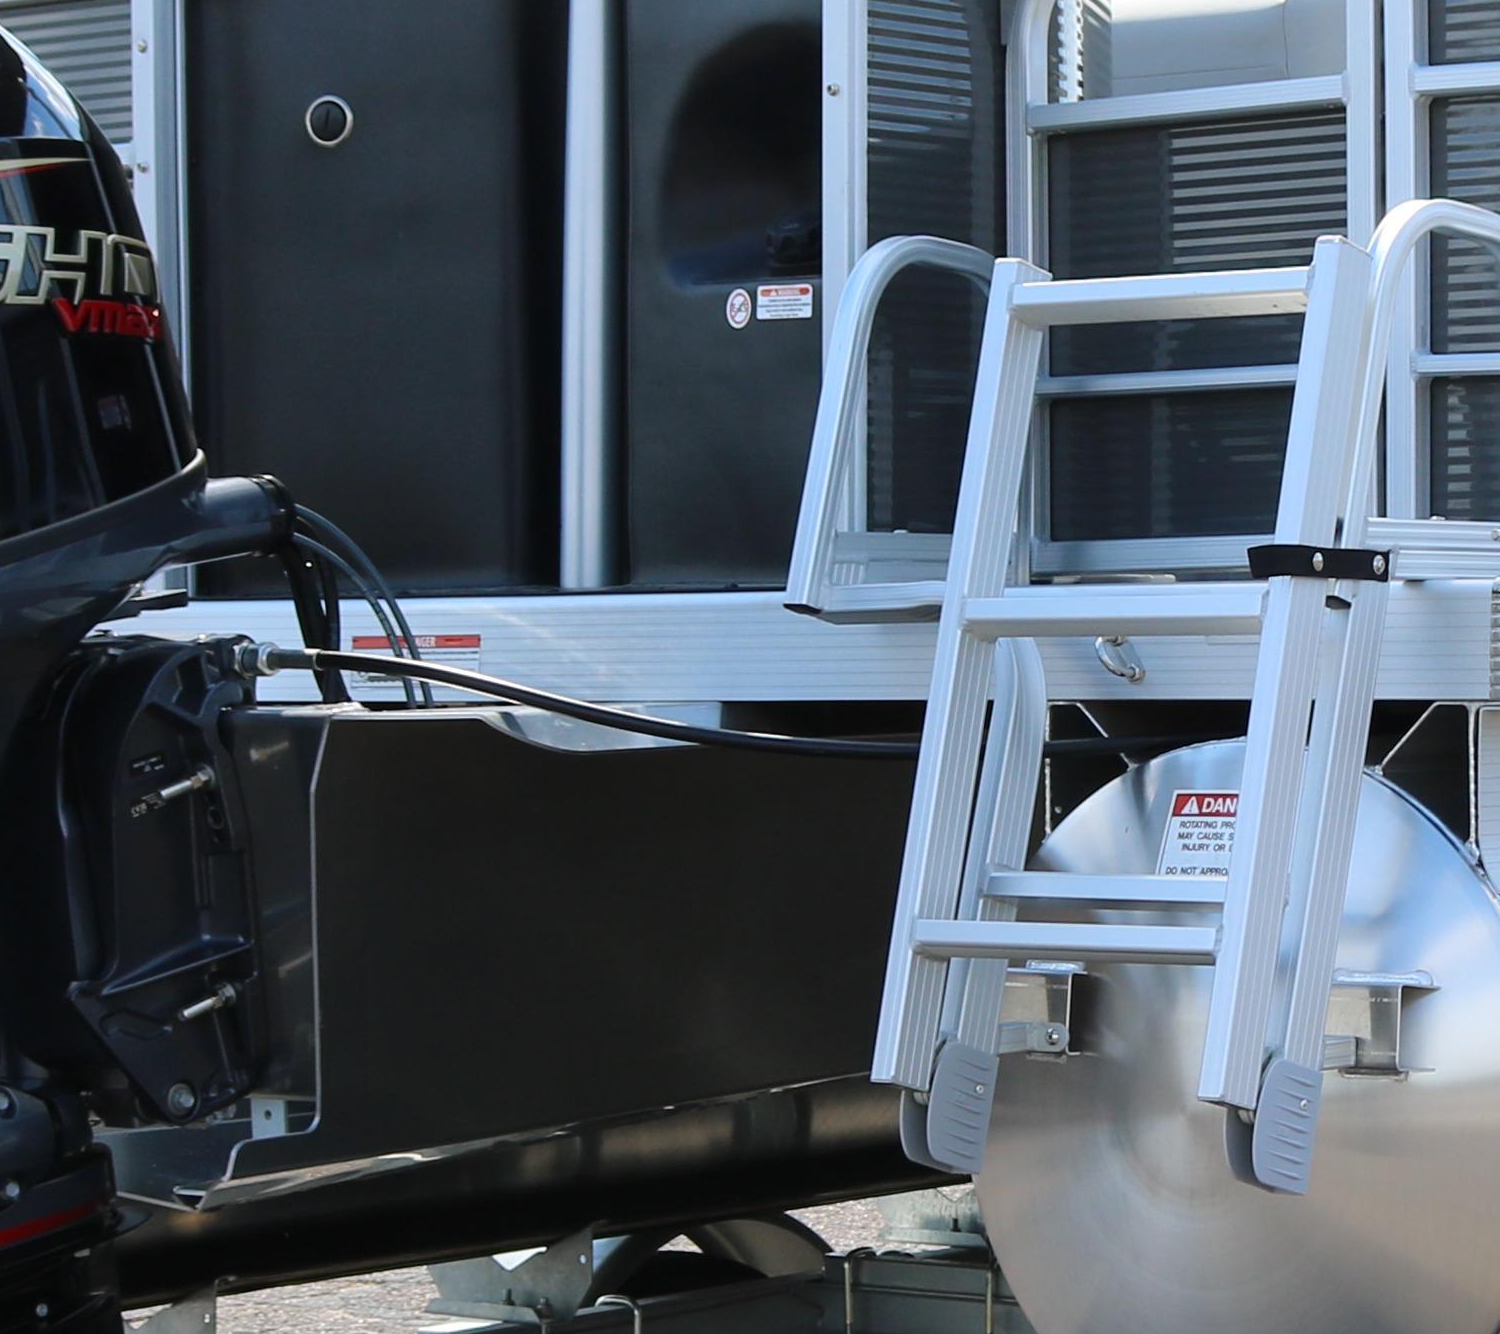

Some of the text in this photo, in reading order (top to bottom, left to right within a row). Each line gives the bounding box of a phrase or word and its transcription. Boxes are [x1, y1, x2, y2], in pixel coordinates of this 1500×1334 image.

[1201, 797, 1238, 813] DAN
[1179, 820, 1217, 830] ROTATING
[1177, 831, 1195, 840] MAY
[1196, 831, 1225, 841] CAUSE
[1181, 843, 1212, 852] INJURY
[1213, 843, 1226, 852] OR
[1165, 866, 1229, 876] DO NOT APPRO
